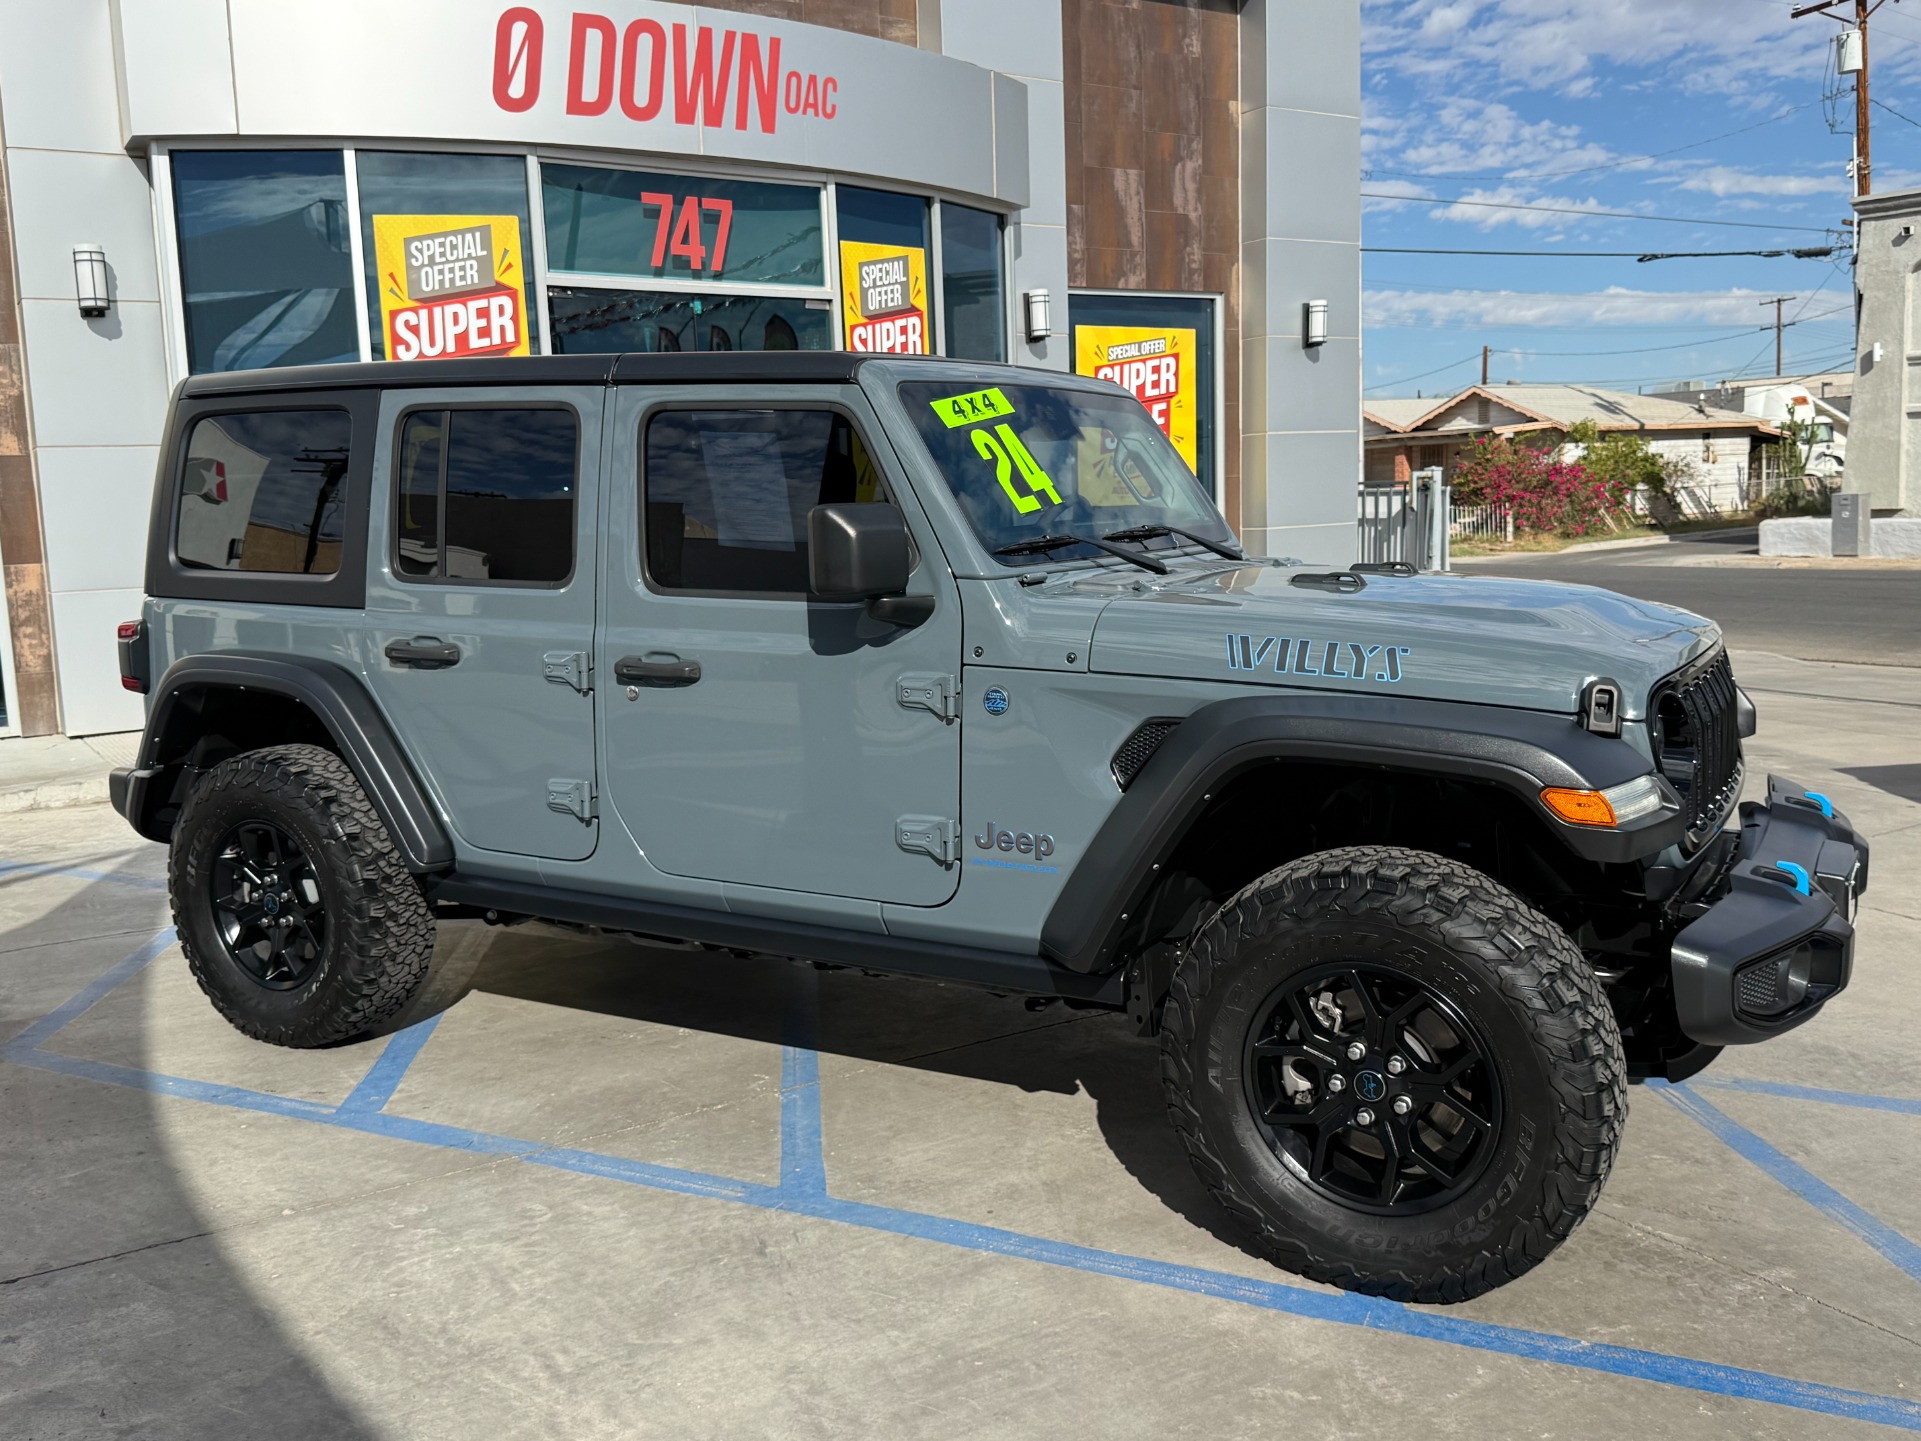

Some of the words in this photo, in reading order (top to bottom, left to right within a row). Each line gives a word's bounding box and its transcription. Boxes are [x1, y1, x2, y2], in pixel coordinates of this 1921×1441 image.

[492, 6, 544, 113] 0
[566, 12, 781, 134] DOWN
[785, 71, 838, 120] OAC
[410, 232, 487, 267] SPECIAL
[641, 192, 733, 271] 747
[420, 260, 479, 292] OFFER
[862, 260, 907, 288] SPECIAL
[867, 284, 902, 311] OFFER
[394, 295, 516, 361] SUPER
[1108, 343, 1141, 361] SPECIAL
[1141, 338, 1166, 357] OFFER
[970, 423, 1063, 514] 24
[1226, 633, 1411, 682] WILLYS
[975, 821, 1055, 861] Jeep
